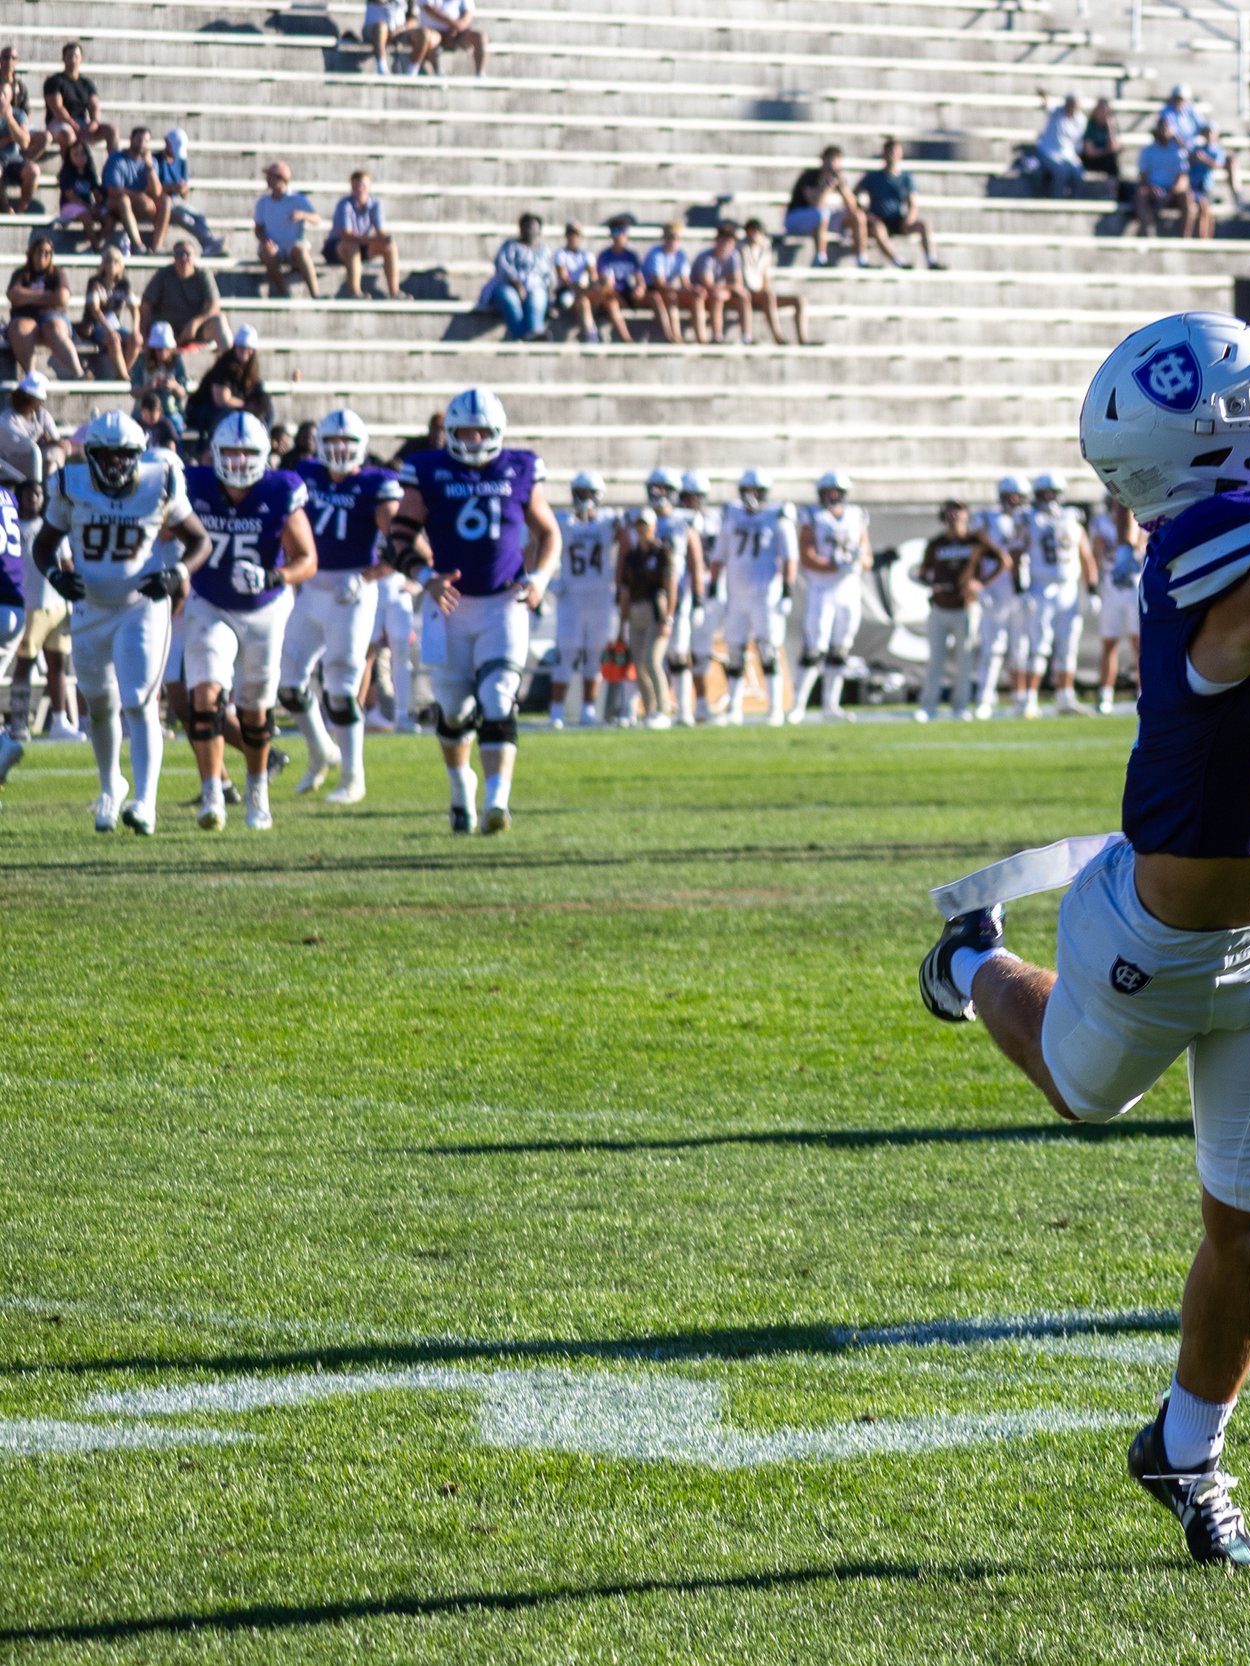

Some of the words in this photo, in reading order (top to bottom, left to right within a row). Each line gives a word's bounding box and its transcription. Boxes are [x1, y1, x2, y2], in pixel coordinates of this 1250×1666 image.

[446, 483, 474, 498] HOLY
[475, 480, 513, 498] CROSS
[227, 517, 264, 533] CROSS
[312, 498, 349, 541] 71
[456, 496, 501, 541] 61
[82, 523, 146, 563] 99
[207, 531, 263, 568] 75
[568, 543, 603, 576] 64
